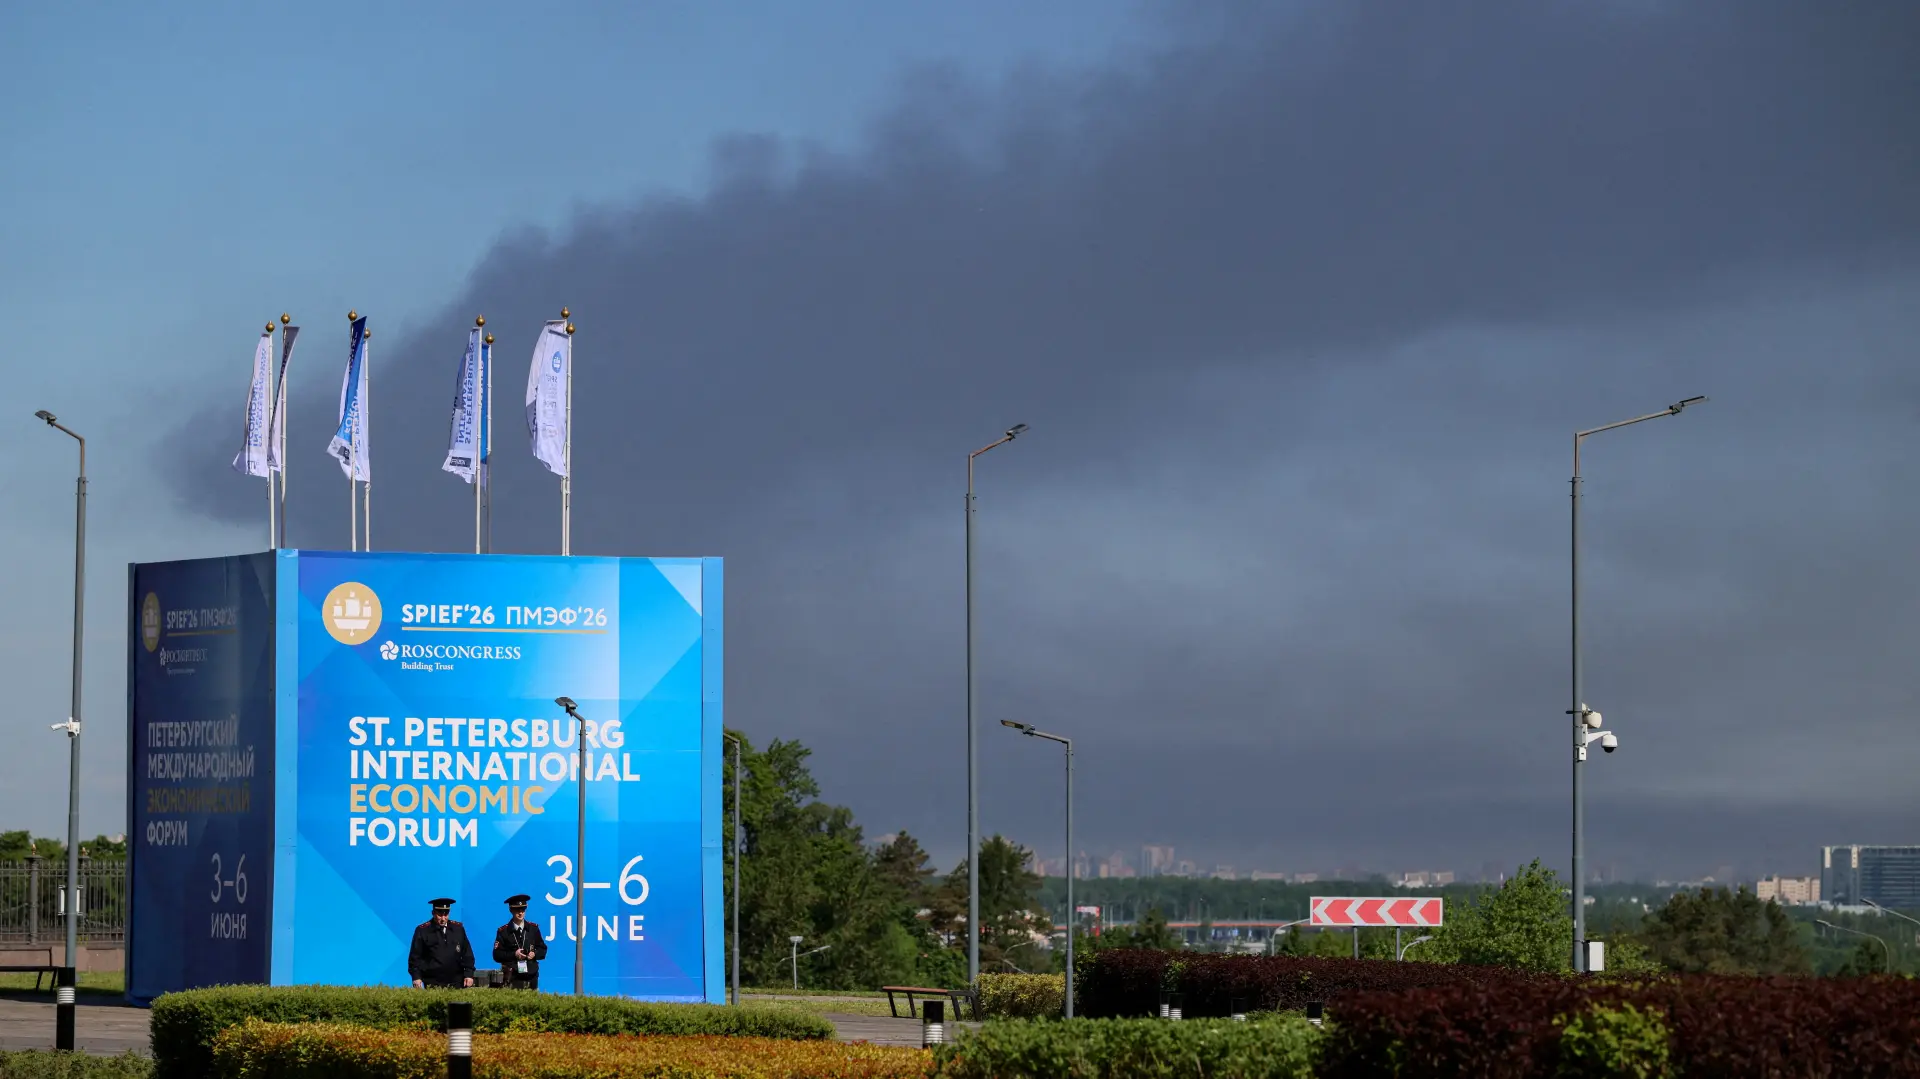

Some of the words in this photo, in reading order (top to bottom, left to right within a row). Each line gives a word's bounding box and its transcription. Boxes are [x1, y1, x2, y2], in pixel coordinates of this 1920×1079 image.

[402, 604, 495, 625] SPIEF‘26
[506, 606, 608, 627] ПМЭФ‘26
[401, 644, 521, 660] ROSCONGRESS
[401, 661, 433, 673] Building
[435, 662, 454, 671] Trust
[148, 713, 238, 748] ПЕТЕРБУРГСКИЙ
[349, 717, 395, 747] ST.
[405, 717, 624, 749] PETERSBURG
[148, 744, 254, 782] МЕЖДУНАРОДНЫЙ
[350, 751, 640, 782] INTERNATIONAL
[350, 784, 545, 815] ECONOMIC
[147, 820, 188, 846] ФОРУМ
[349, 817, 478, 847] FORUM
[210, 913, 247, 941] ИЮНЯ
[545, 915, 645, 942] JUNE
